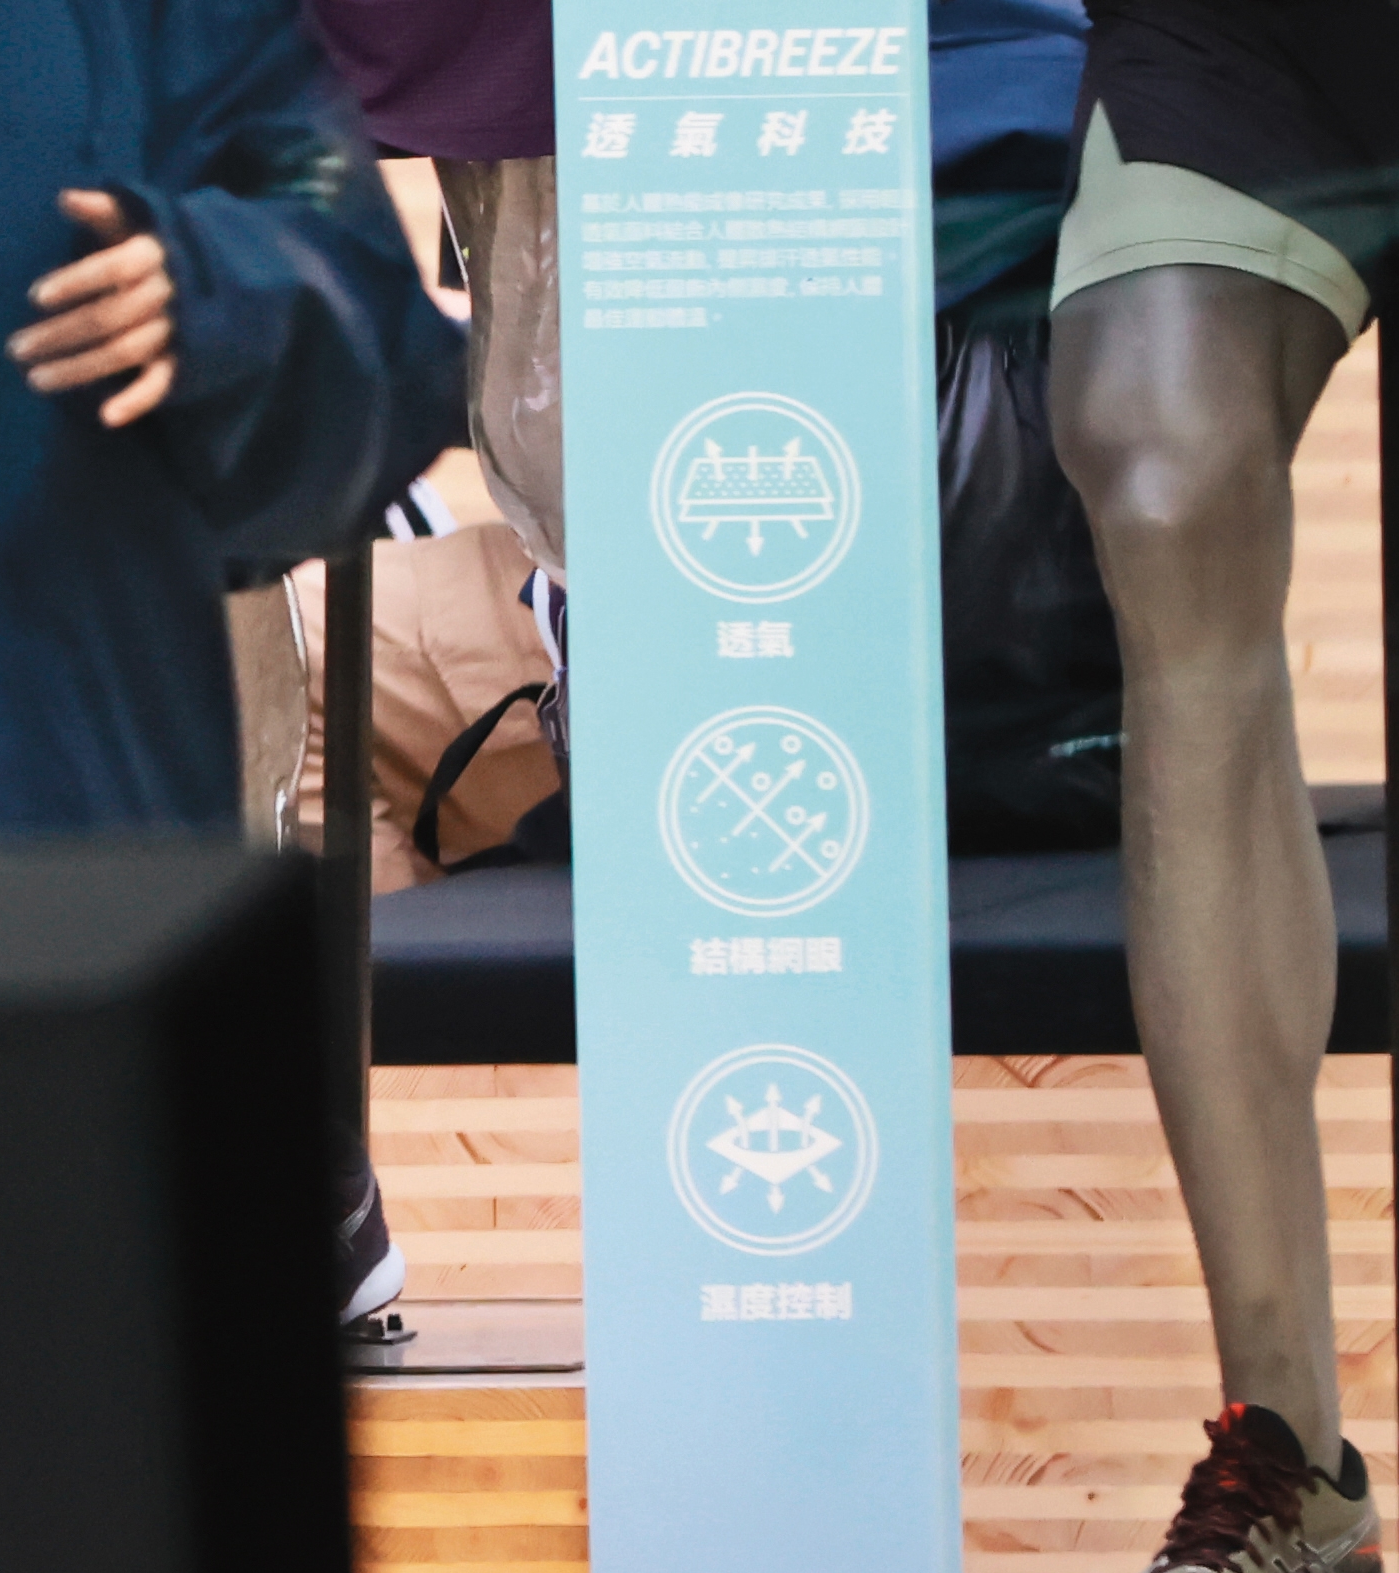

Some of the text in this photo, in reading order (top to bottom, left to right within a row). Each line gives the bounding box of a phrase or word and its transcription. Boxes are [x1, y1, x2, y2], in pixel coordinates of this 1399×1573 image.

[577, 27, 908, 80] ACTIBREEZE
[581, 107, 898, 159] 透氣科技
[716, 620, 795, 659] 透氣
[689, 936, 843, 975] 結構網眼
